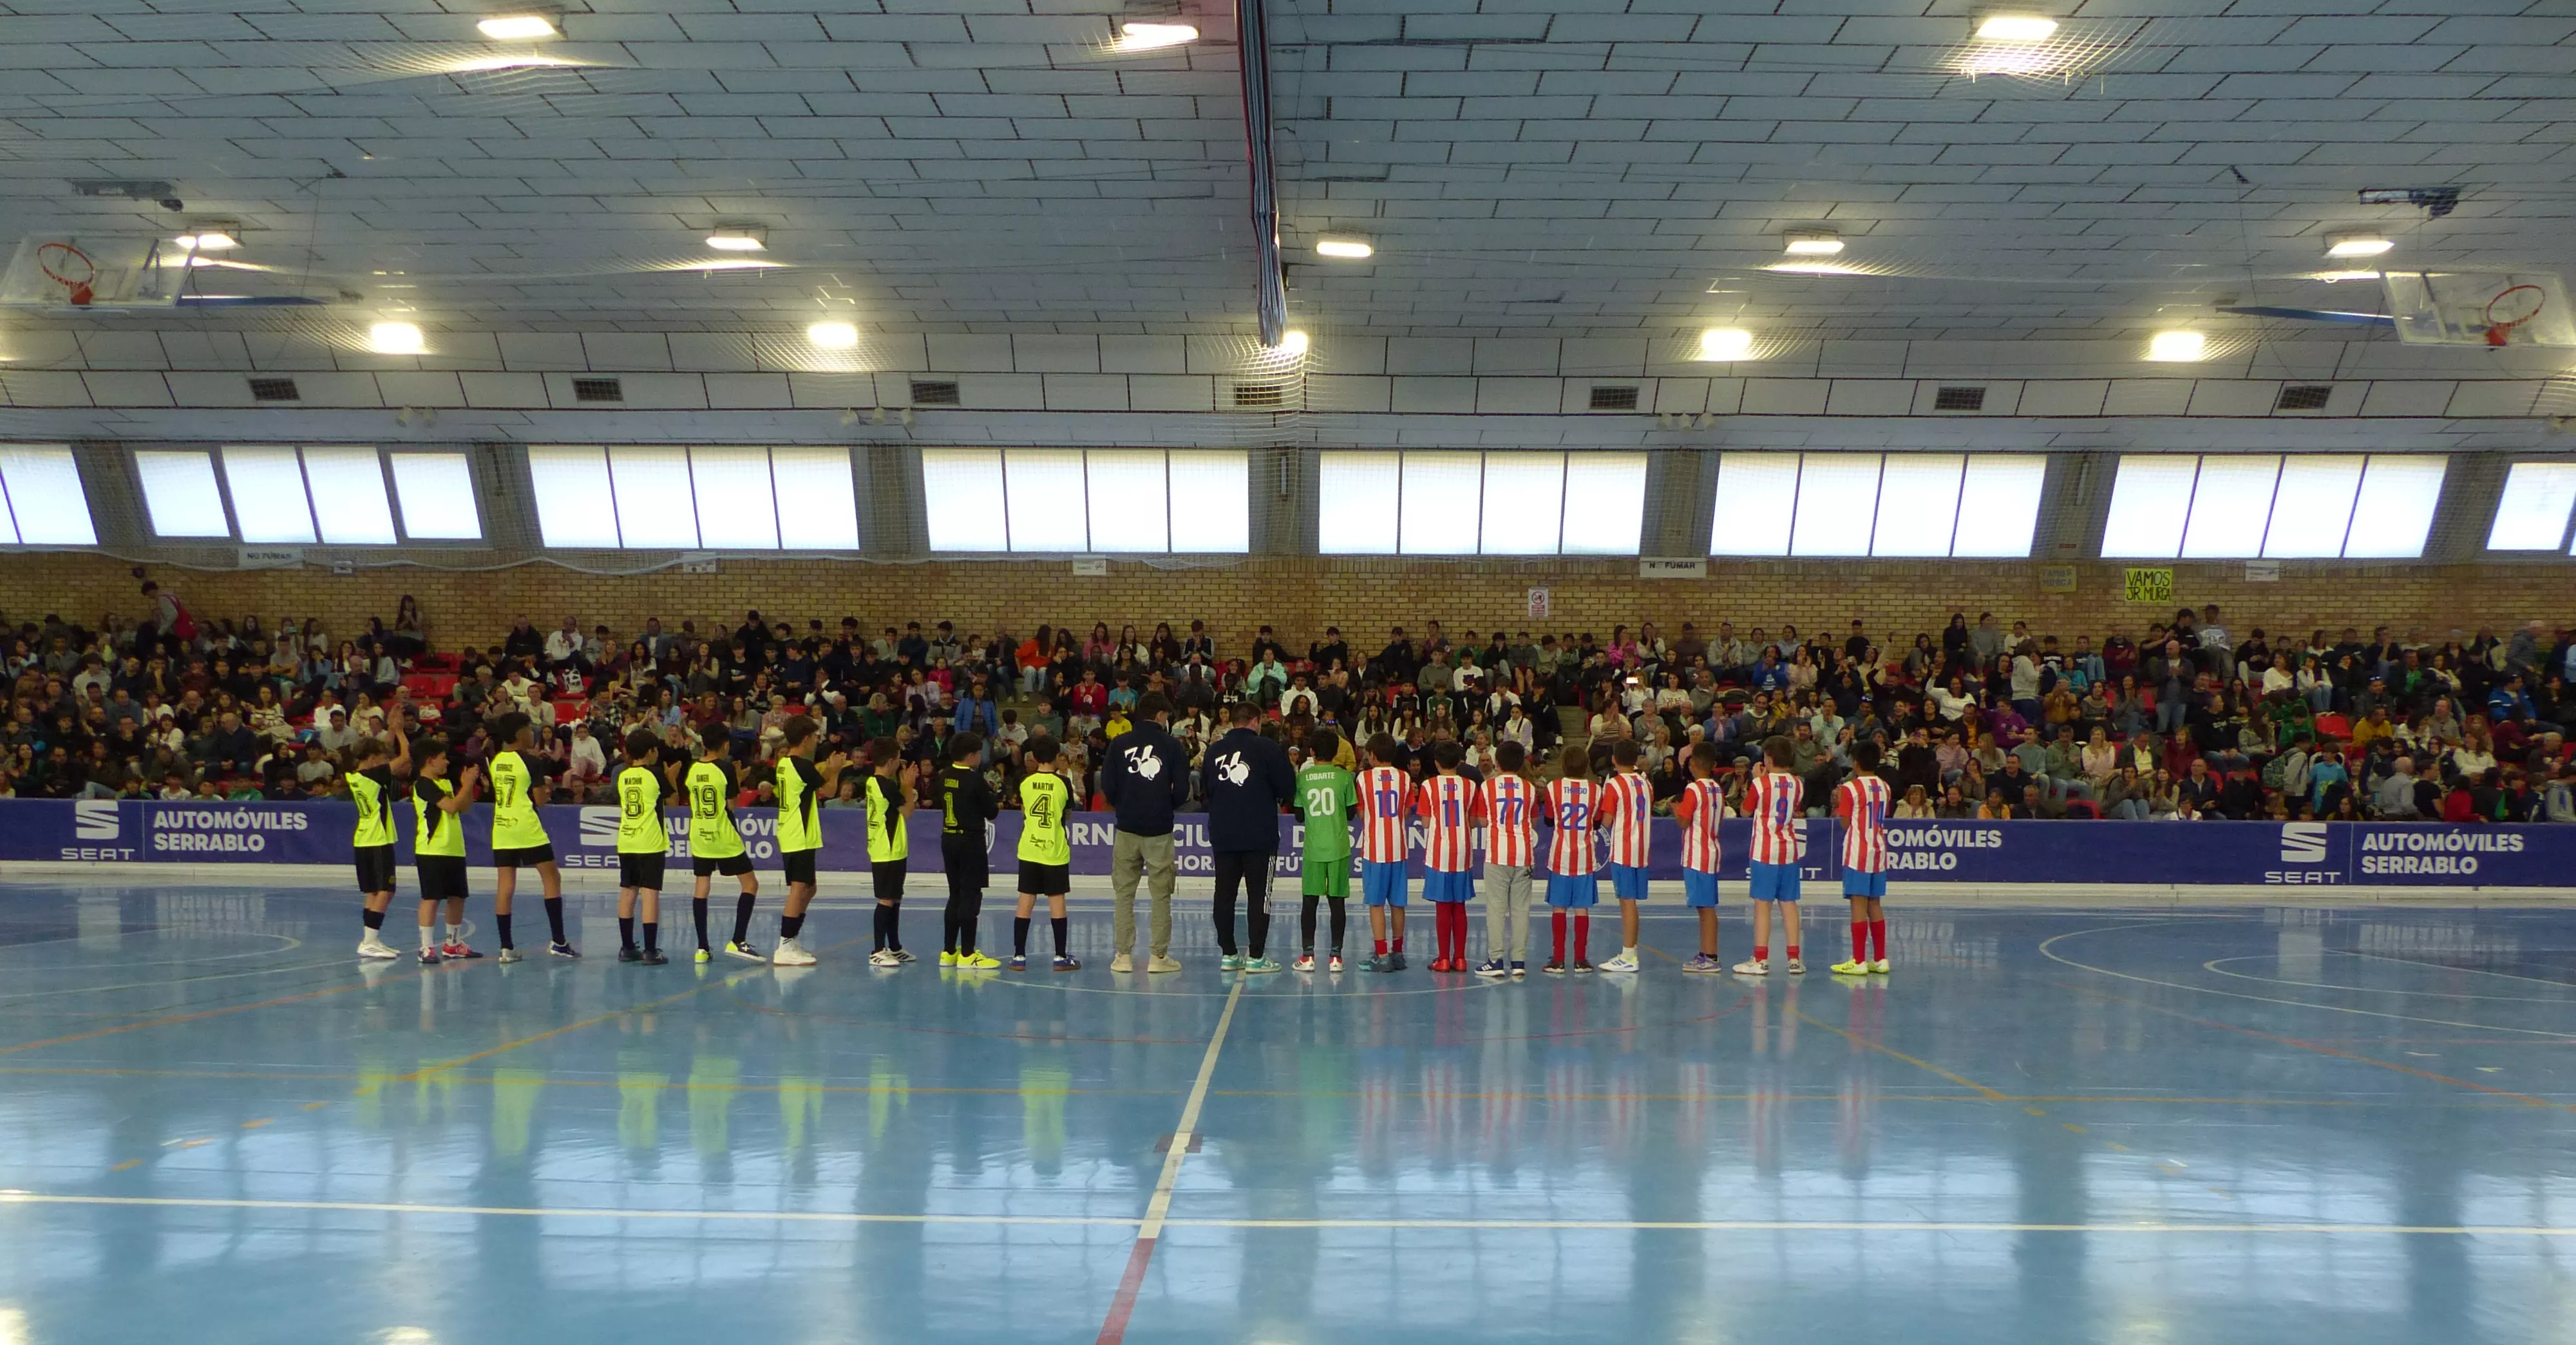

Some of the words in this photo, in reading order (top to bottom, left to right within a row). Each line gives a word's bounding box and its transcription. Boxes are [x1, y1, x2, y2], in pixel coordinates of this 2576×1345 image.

[2126, 570, 2170, 587] VAMOS
[2144, 587, 2171, 601] MURGA
[1305, 772, 1335, 781] LOBARTE
[625, 787, 644, 819] 8
[692, 785, 718, 819] 19
[944, 791, 958, 827] 1
[1030, 794, 1054, 829] 4
[1307, 787, 1335, 816] 20
[1375, 790, 1398, 818] 10
[1442, 800, 1460, 827] 11
[1496, 797, 1524, 825] 77
[1775, 797, 1788, 824] 9
[154, 807, 308, 831] AUTOMÓVILES
[1562, 802, 1588, 831] 22
[1868, 800, 1884, 829] 14
[155, 833, 265, 851] SERRABLO
[1883, 824, 2002, 848] OMÓVILES
[2362, 829, 2523, 852] AUTOMÓVILES
[61, 848, 136, 860] SEAT
[565, 855, 620, 867] SEA
[1886, 852, 1957, 870] RABLO
[2362, 856, 2477, 874] SERRABLO
[2264, 871, 2341, 883] SEAT
